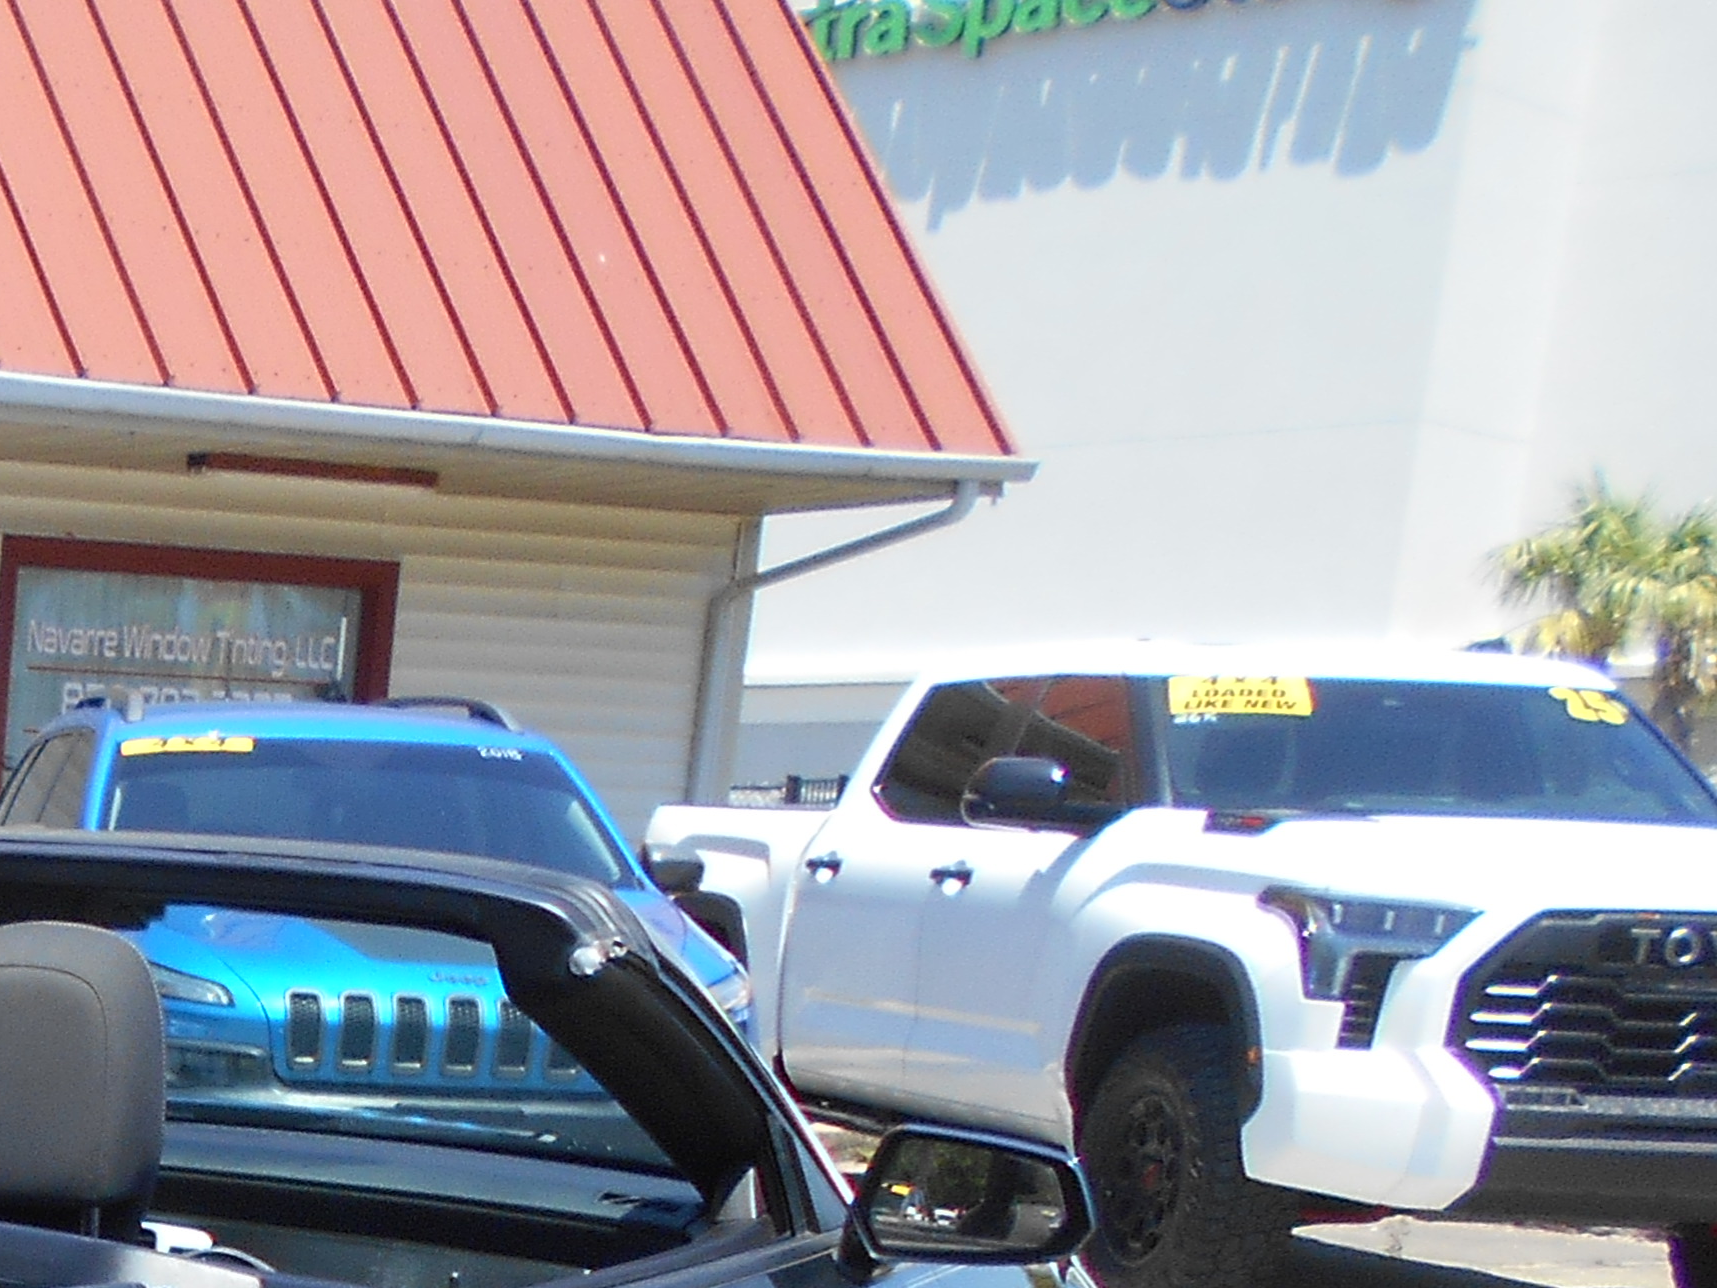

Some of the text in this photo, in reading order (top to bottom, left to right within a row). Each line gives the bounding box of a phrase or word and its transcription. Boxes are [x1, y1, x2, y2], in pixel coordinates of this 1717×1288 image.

[26, 619, 118, 658] Navarre
[122, 624, 210, 664] Window
[293, 635, 336, 670] LLC
[1192, 688, 1286, 698] LOADED
[1183, 699, 1297, 710] LIKE NEW
